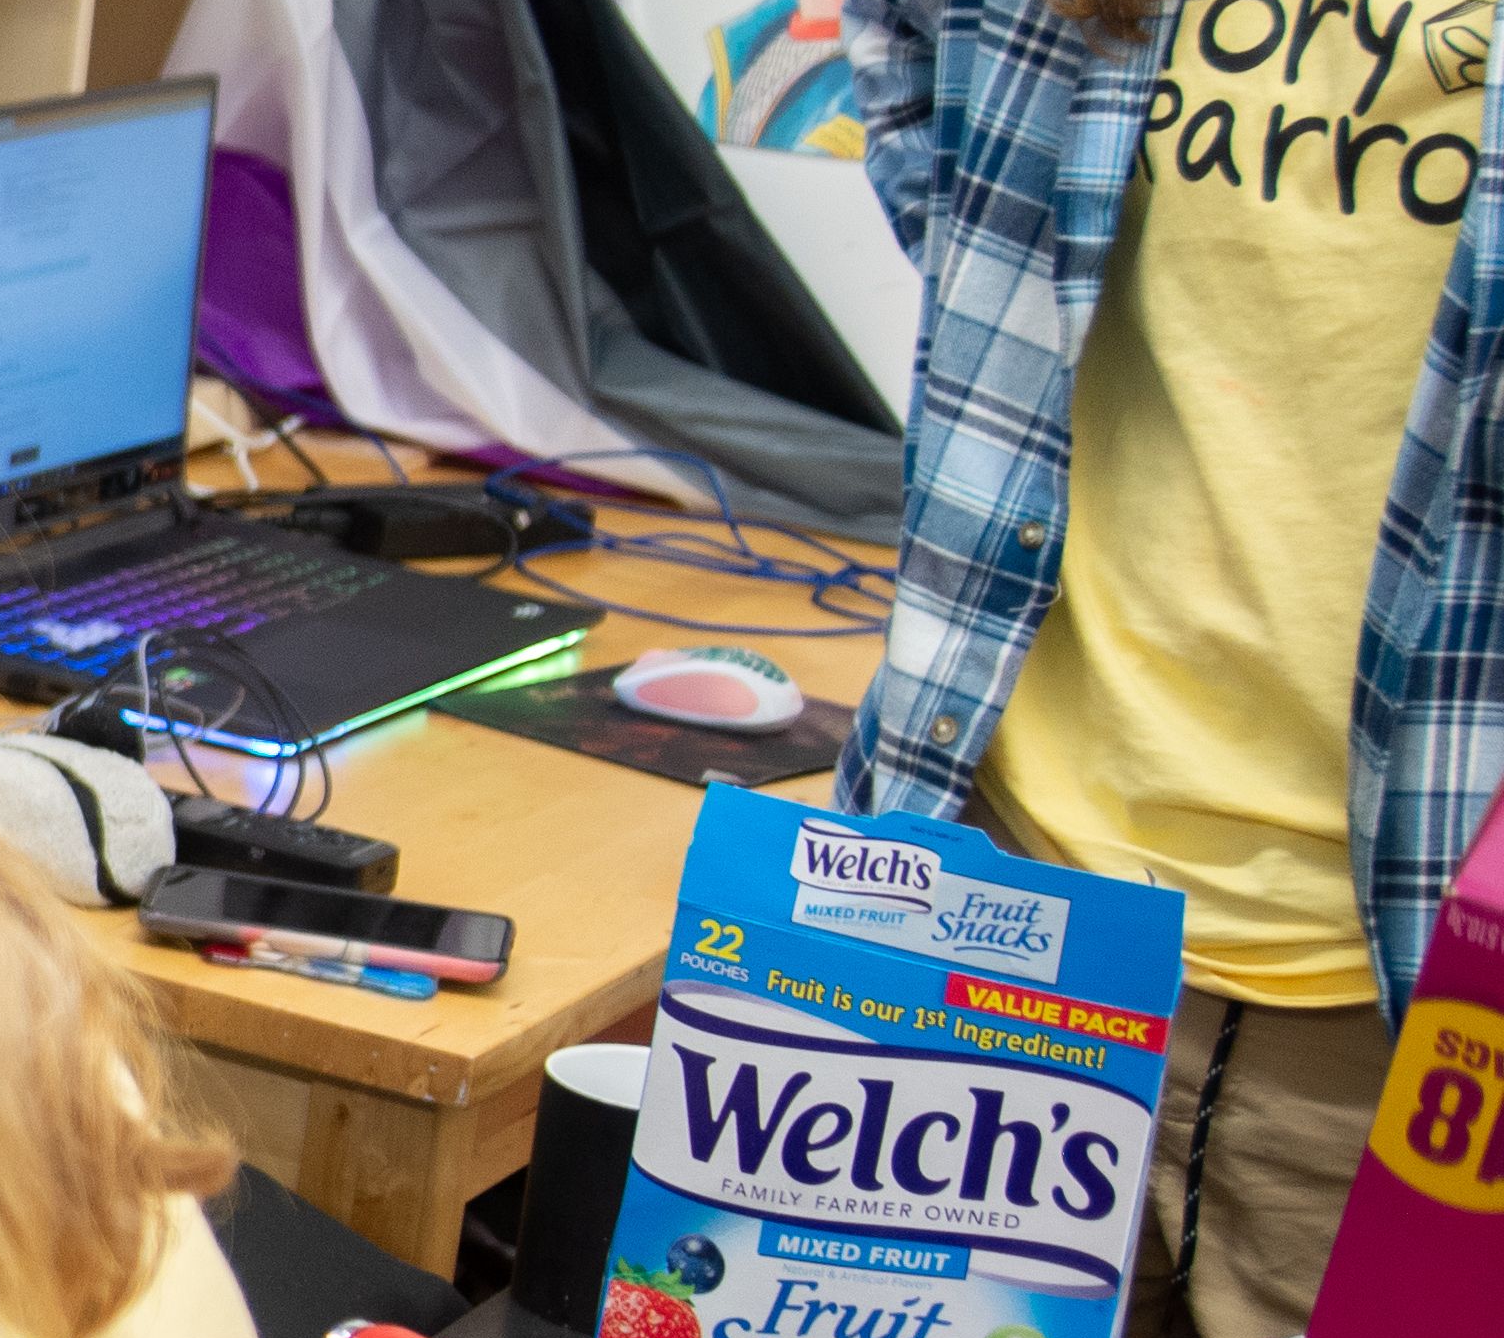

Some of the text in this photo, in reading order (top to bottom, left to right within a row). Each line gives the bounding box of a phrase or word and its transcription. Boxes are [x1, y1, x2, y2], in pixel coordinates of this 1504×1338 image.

[802, 837, 933, 892] Welch's
[803, 902, 854, 921] MIXED
[857, 907, 909, 927] FRUIT
[958, 890, 1044, 925] Fruit
[694, 918, 745, 963] 22
[931, 910, 1053, 954] Snacks
[679, 951, 750, 983] POUCHES
[766, 968, 1108, 1071] Fruit is our 1st Ingredient!
[965, 983, 1152, 1044] VALUE PACK
[670, 1041, 1122, 1223] Welch's
[720, 1177, 1022, 1231] FAMILY FARMER OWNED
[776, 1233, 952, 1274] MIXED FRUIT
[782, 1262, 826, 1279] Natural
[826, 1268, 837, 1280] &
[890, 1275, 934, 1292] Flavors
